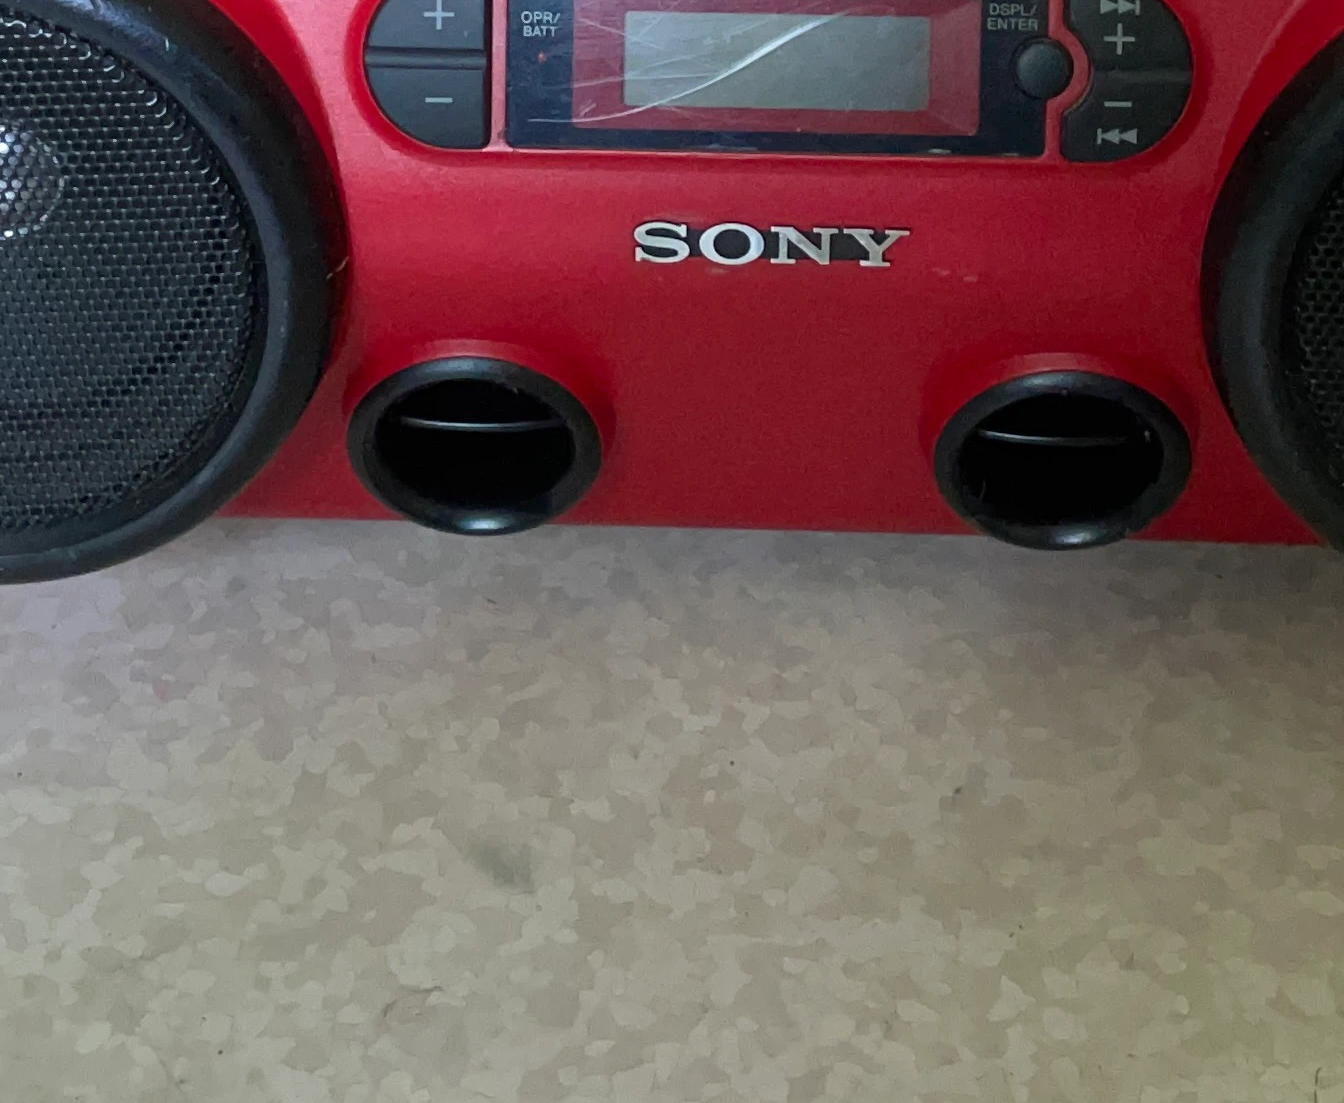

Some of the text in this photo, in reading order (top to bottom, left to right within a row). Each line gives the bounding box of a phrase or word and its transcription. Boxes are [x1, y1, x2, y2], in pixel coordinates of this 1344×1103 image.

[520, 10, 561, 27] OPR/
[989, 2, 1038, 19] DSPL/
[522, 25, 558, 38] BATT
[987, 17, 1039, 32] ENTER
[633, 221, 911, 267] SONY
